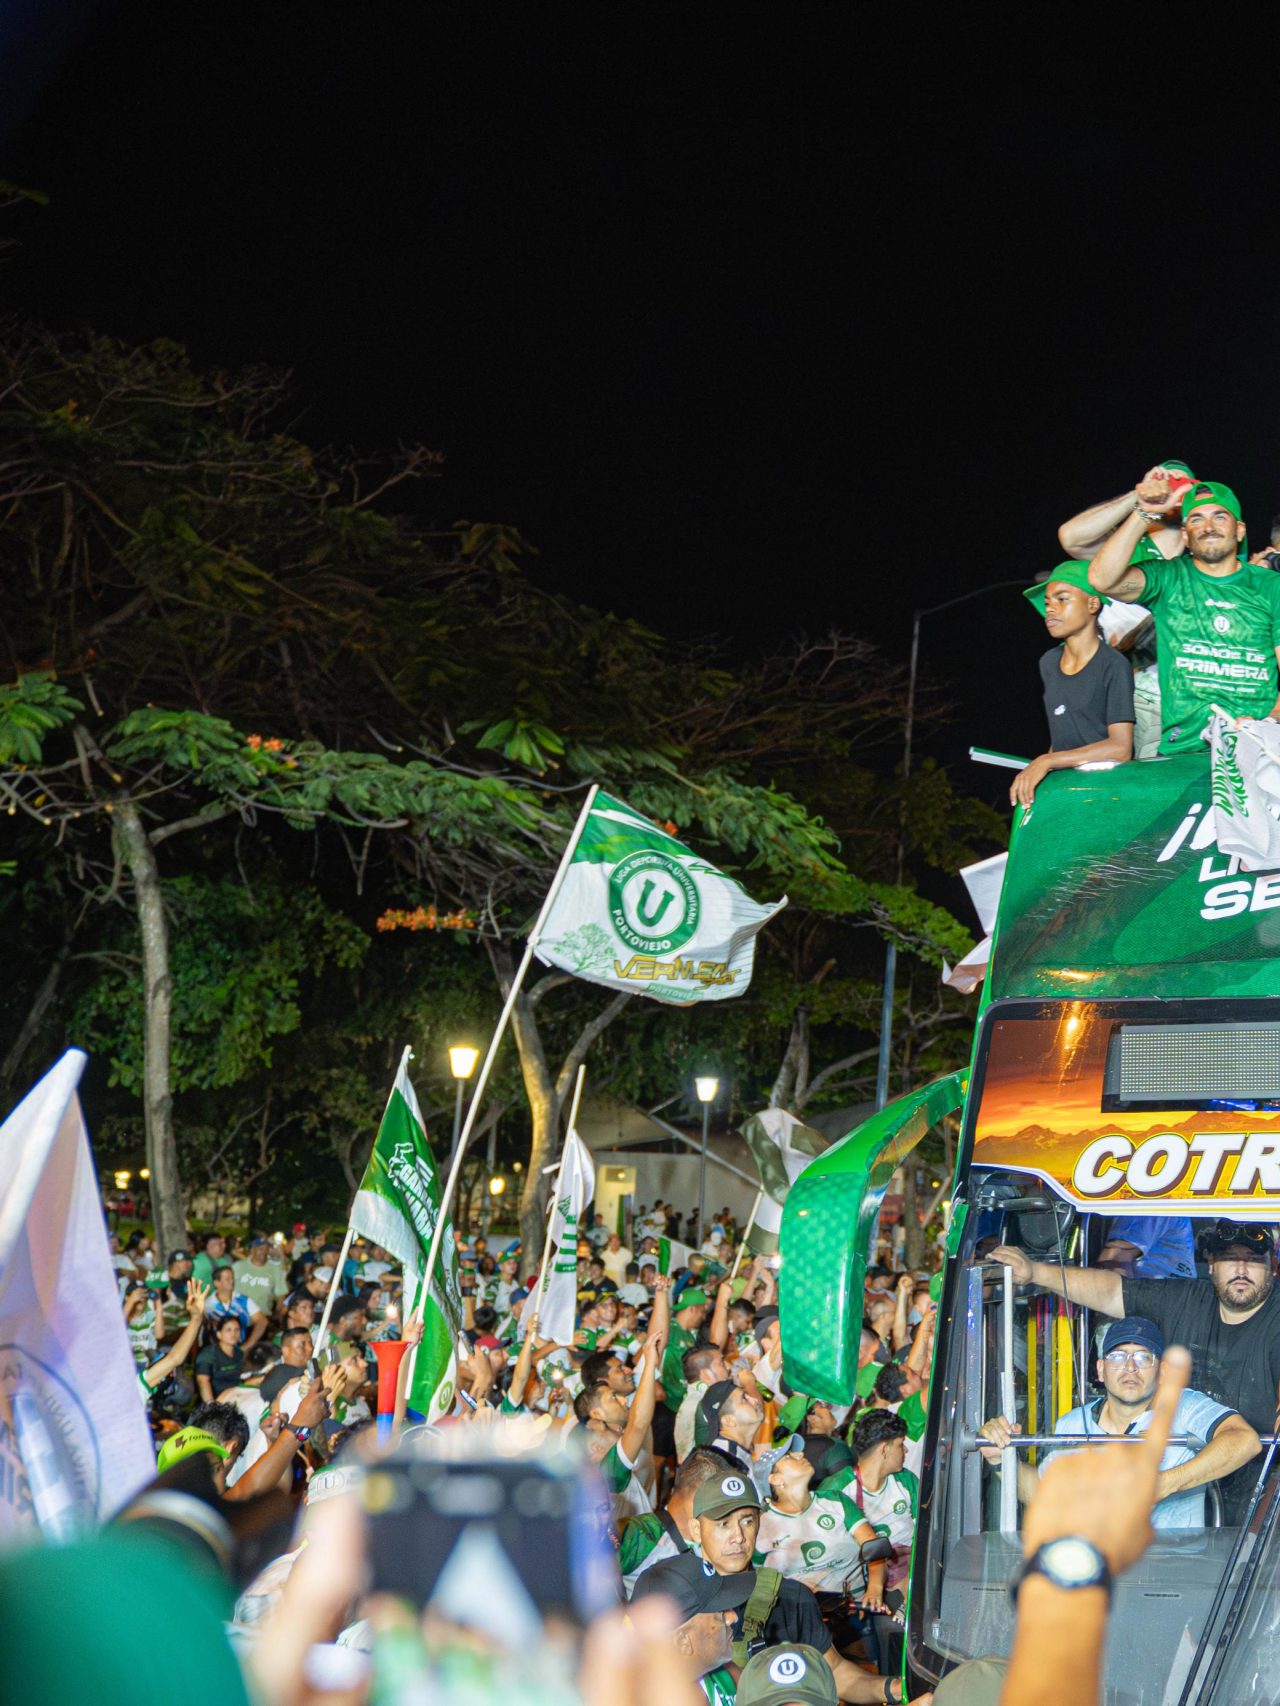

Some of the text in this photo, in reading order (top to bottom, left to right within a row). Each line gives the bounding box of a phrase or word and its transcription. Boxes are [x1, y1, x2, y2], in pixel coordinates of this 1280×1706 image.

[1176, 656, 1270, 681] PRIMERA
[1182, 643, 1266, 664] SOMOS DE
[636, 878, 676, 928] U
[612, 908, 672, 951] PORTOVIEJO
